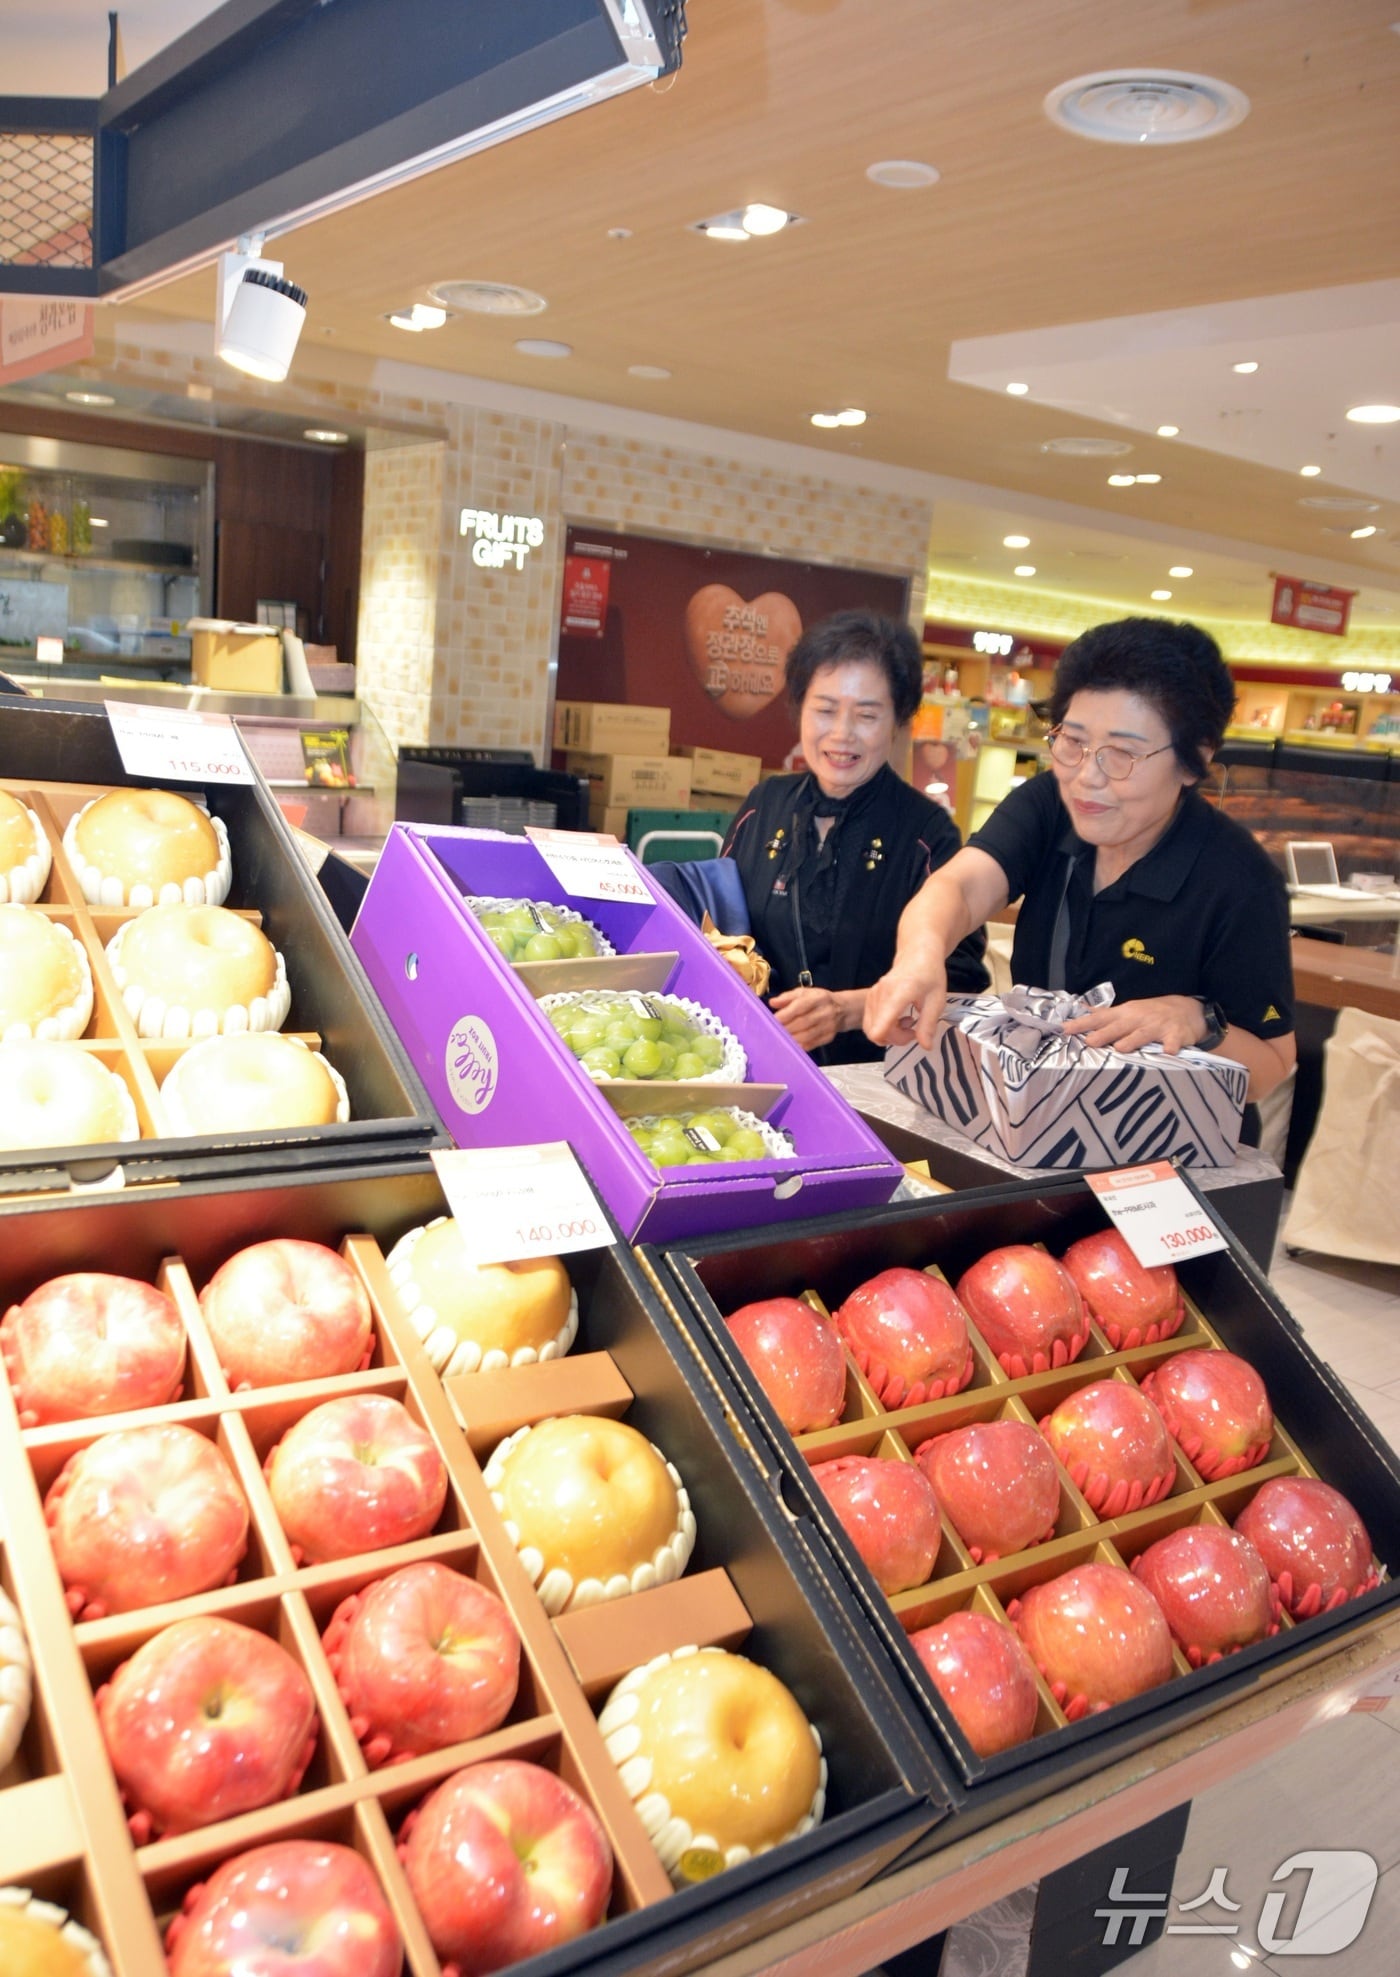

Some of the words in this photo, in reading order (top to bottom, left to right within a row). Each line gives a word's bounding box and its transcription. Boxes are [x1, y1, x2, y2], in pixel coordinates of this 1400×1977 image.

[459, 508, 544, 547] FRUITS
[472, 538, 530, 571] GIFT
[722, 604, 769, 637] 추석엔
[705, 630, 779, 665] 정관장으로
[450, 1032, 494, 1105] hello
